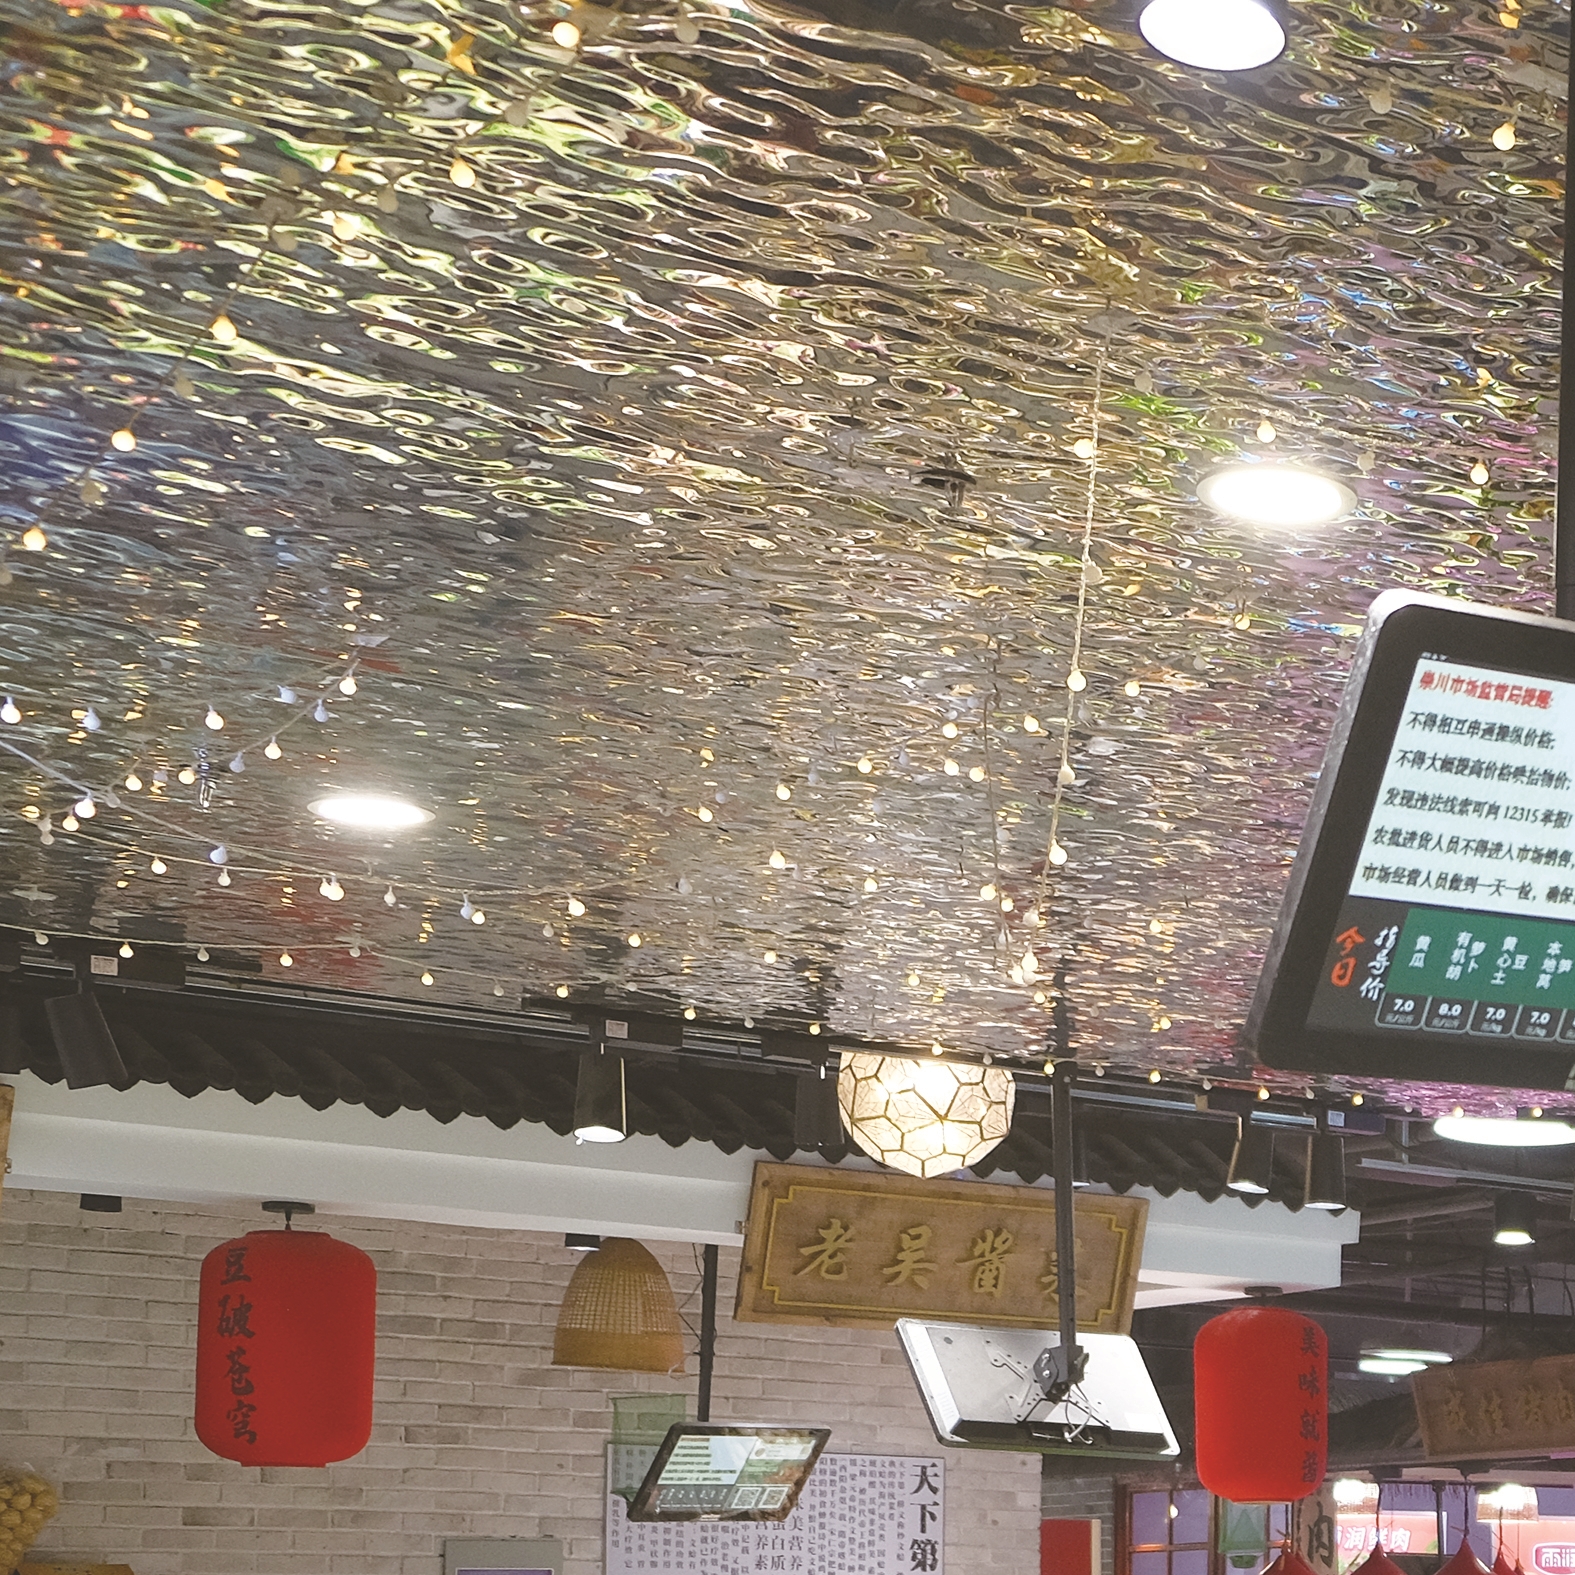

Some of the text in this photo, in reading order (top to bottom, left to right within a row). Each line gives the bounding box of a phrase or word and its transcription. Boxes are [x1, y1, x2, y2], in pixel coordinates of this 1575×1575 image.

[1331, 926, 1366, 987] 今日
[1359, 925, 1399, 1001] 指导价
[1393, 999, 1415, 1013] 7.0
[1438, 1003, 1462, 1017] 8.0
[1485, 1007, 1506, 1021] 7.0
[1530, 1011, 1551, 1025] 7.0
[217, 1247, 257, 1445] 豆破苍穹
[1297, 1327, 1322, 1484] 美味就酱
